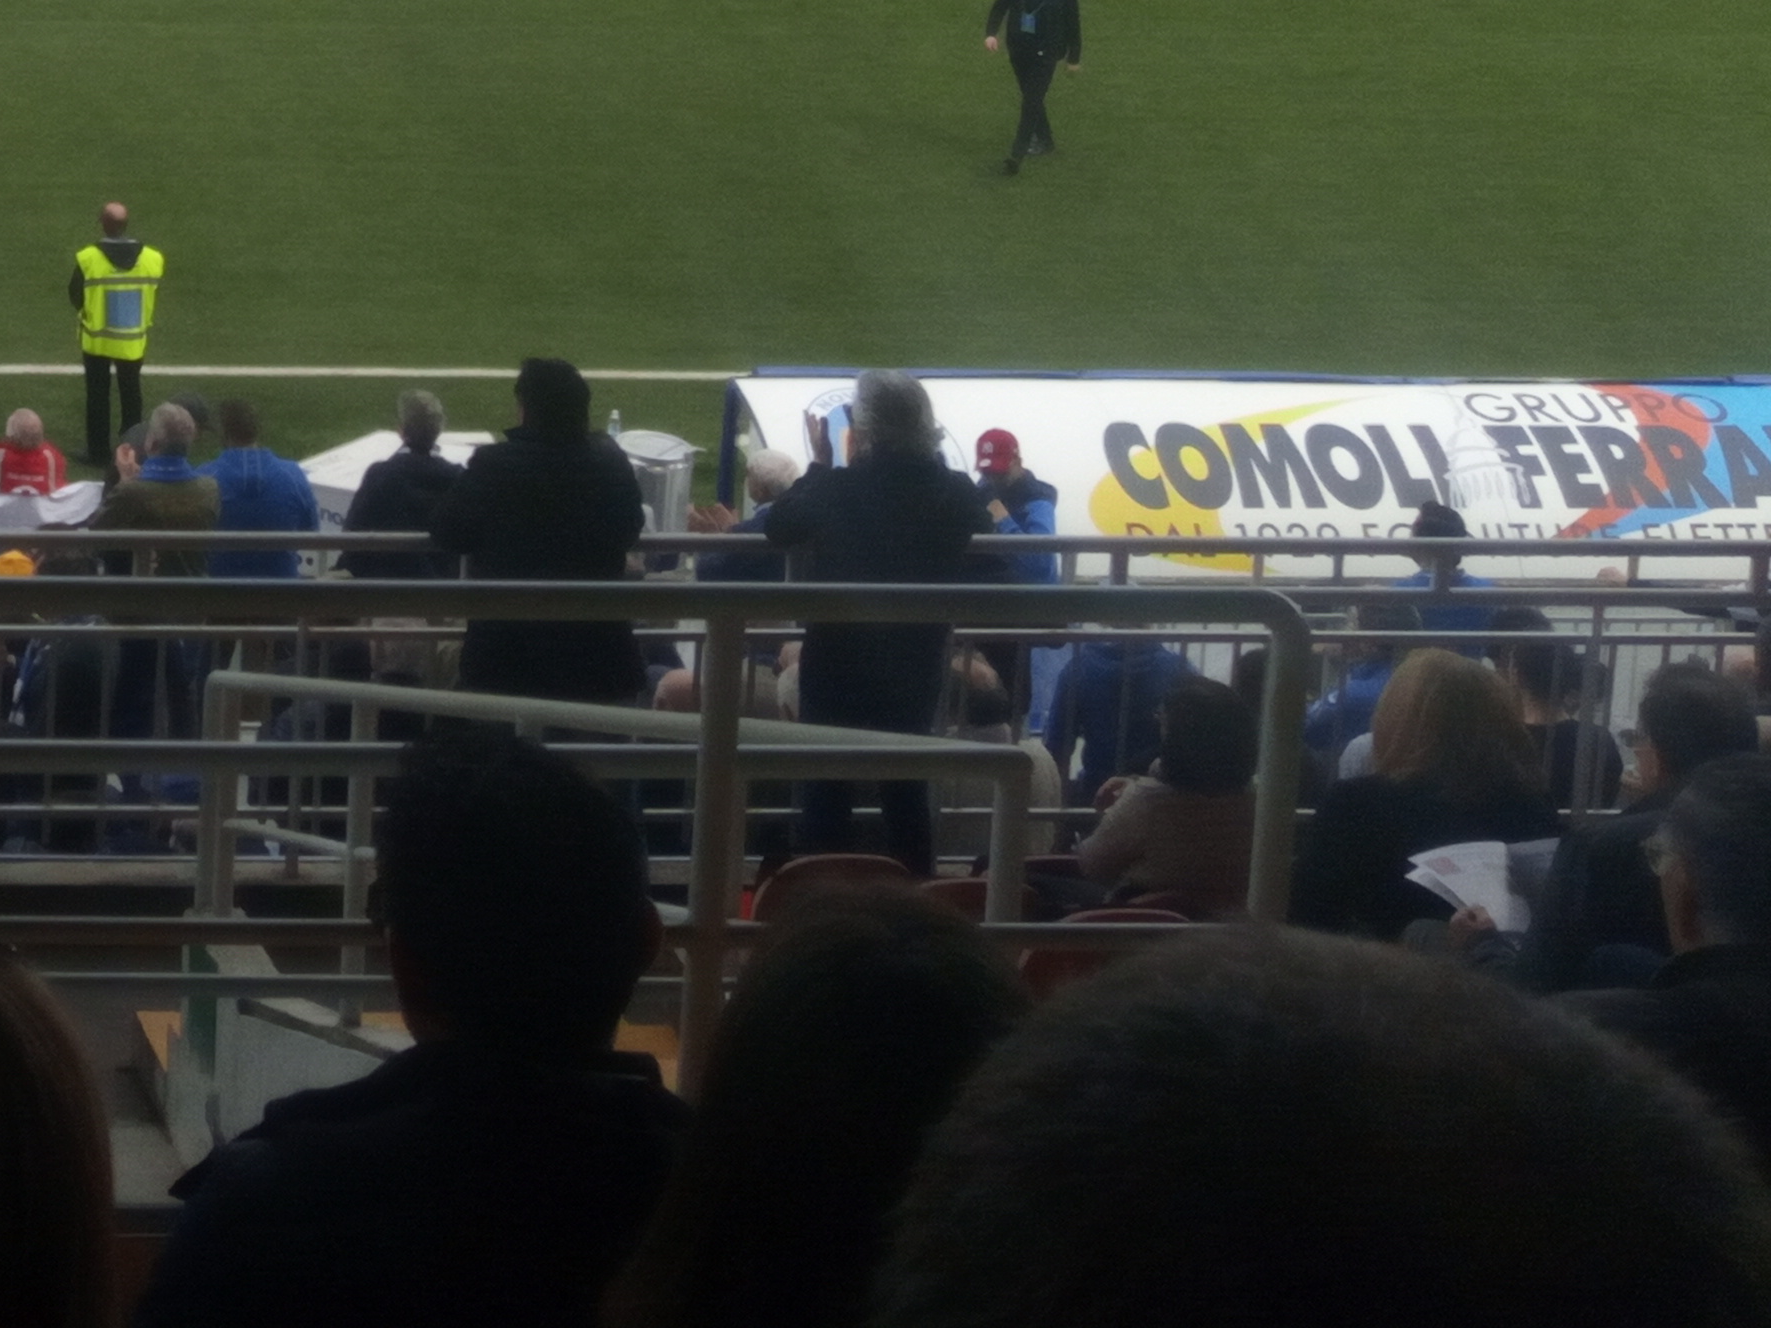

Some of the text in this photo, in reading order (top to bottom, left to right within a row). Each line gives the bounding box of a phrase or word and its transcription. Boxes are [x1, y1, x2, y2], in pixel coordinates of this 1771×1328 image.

[1463, 392, 1729, 424] GRUPPO
[1102, 421, 1771, 510] COMOLI FERRA
